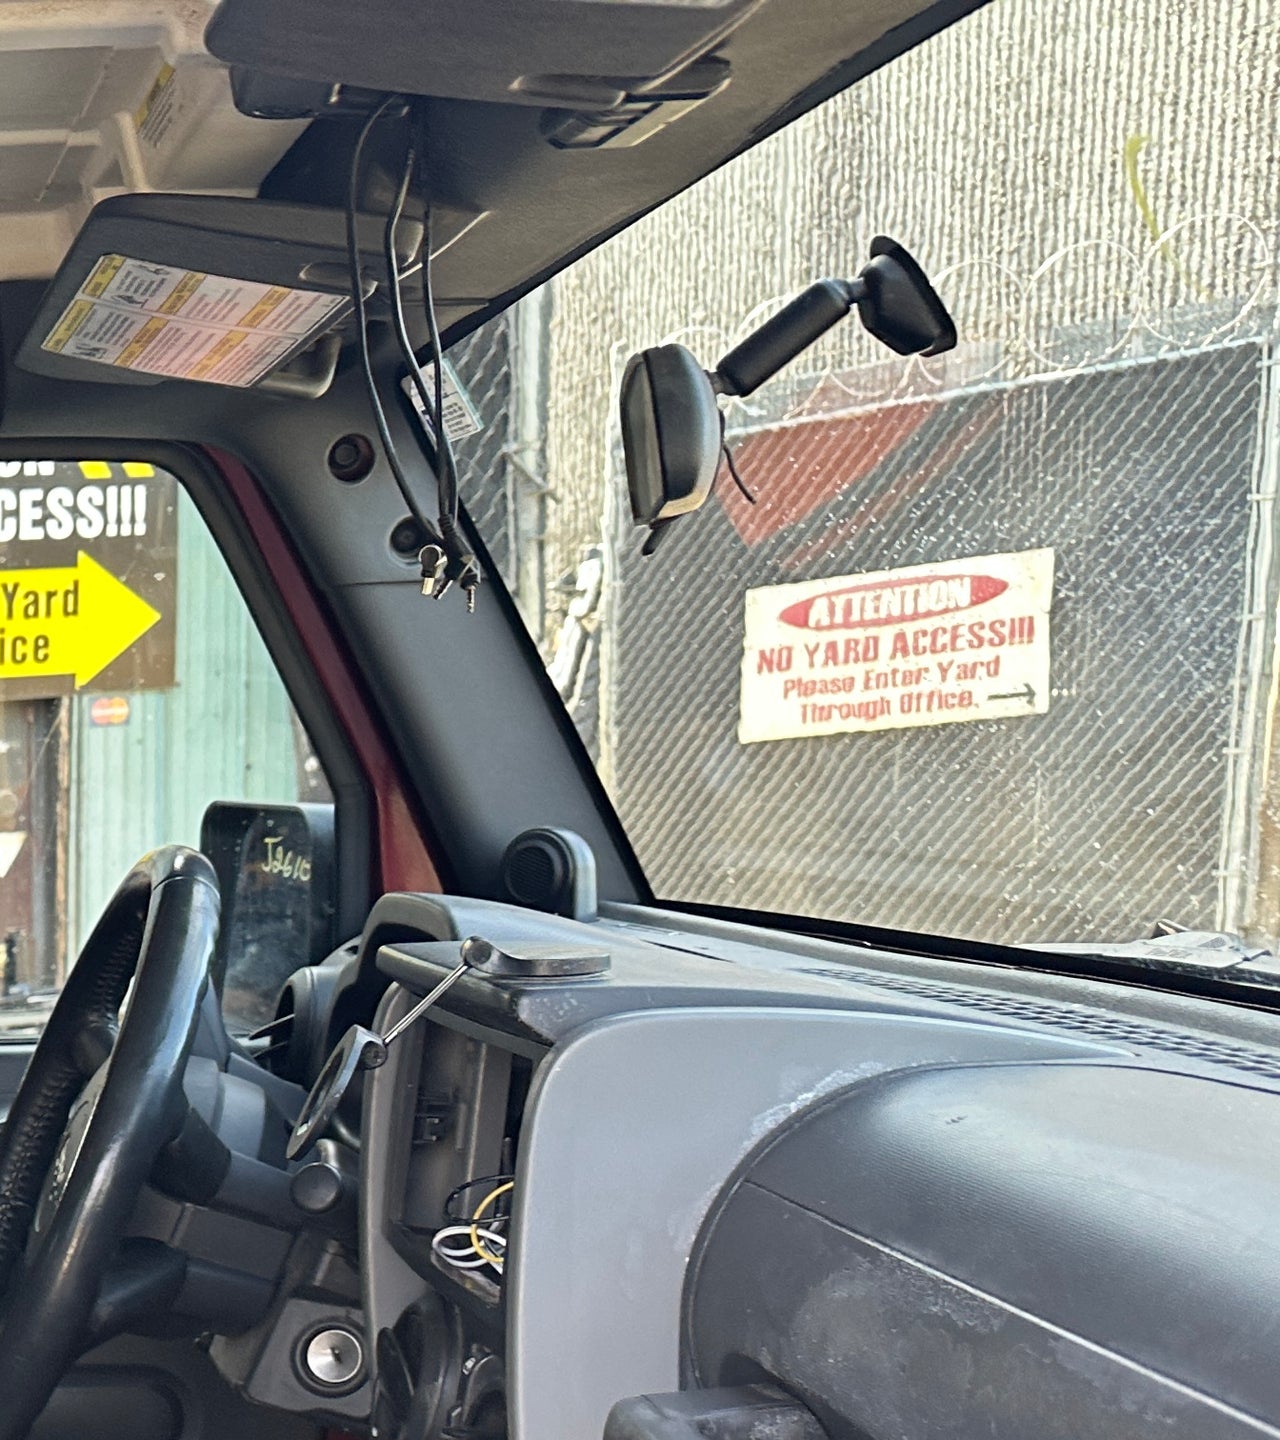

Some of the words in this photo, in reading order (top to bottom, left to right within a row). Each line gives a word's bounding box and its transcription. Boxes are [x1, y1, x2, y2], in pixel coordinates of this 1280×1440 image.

[2, 580, 80, 620] Yard
[808, 577, 972, 628] ATTENTION
[757, 646, 793, 675] NO
[804, 635, 880, 668] YARD
[890, 616, 1036, 660] ACCESS!!!
[783, 673, 855, 700] Please
[863, 666, 925, 692] Enter
[937, 655, 1001, 682] Yard
[801, 696, 890, 725] Through
